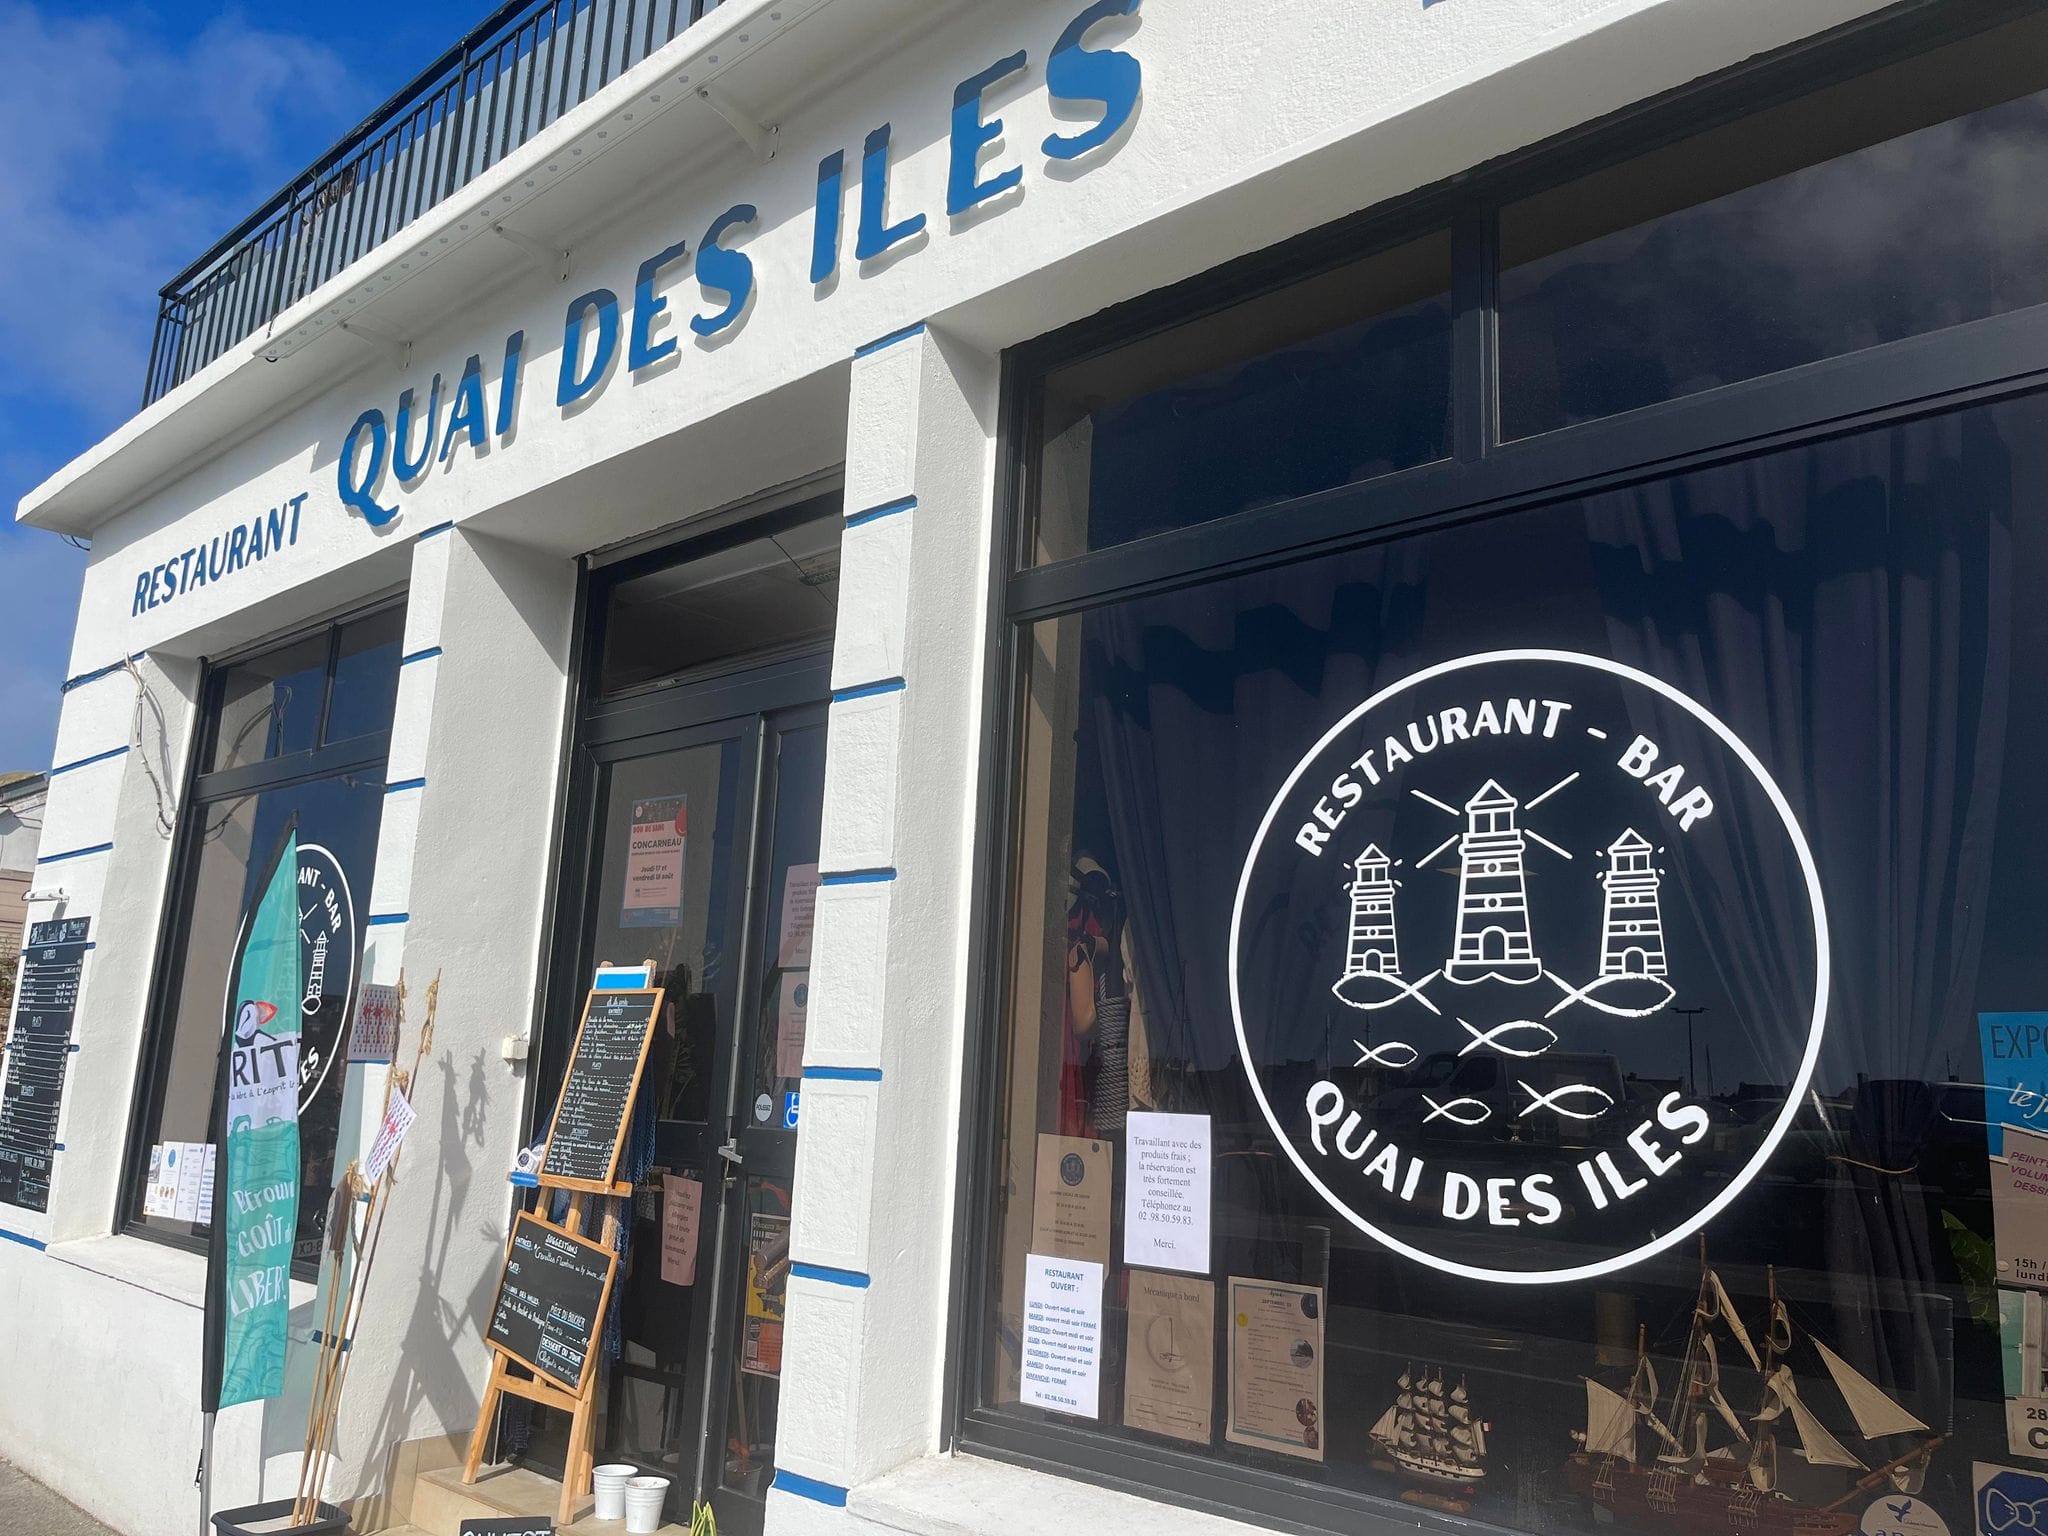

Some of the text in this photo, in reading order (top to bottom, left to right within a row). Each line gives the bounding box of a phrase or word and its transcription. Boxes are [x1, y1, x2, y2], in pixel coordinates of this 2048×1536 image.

[337, 0, 1142, 527] QUAI DES ILES
[132, 491, 309, 617] RESTAURANT
[1295, 698, 1572, 857] RESTAURANT
[1617, 734, 1714, 832] BAR
[632, 838, 682, 850] CONCARNEAU
[641, 865, 655, 873] Jeudi
[632, 873, 655, 881] vendredi
[298, 867, 321, 888] ANT
[325, 889, 342, 934] BAR
[2023, 1094, 2048, 1118] j
[1133, 1136, 1202, 1150] Travaillant avec des
[1141, 1150, 1169, 1161] produits
[1171, 1151, 1187, 1161] frais
[1306, 1080, 1710, 1226] QUAI DES ILES
[2010, 1152, 2048, 1168] PEINT
[1138, 1161, 1196, 1175] la réservation est
[1143, 1175, 1191, 1187] très fortement
[2013, 1180, 2048, 1196] DESSI
[1148, 1188, 1185, 1199] conseillée.
[1141, 1199, 1192, 1212] Téléphonez au
[1138, 1211, 1147, 1221] 02
[238, 1213, 283, 1257] GOÛT
[545, 1233, 578, 1255] SUGGESTIONS
[1153, 1237, 1176, 1249] Merci.
[2014, 1258, 2037, 1269] 15h
[1045, 1268, 1085, 1281] RESTAURANT
[228, 1265, 287, 1317] LIBER
[1050, 1281, 1075, 1292] OUVERT
[1183, 1292, 1201, 1304] bord
[1044, 1303, 1060, 1312] Ouvert
[1080, 1321, 1097, 1330] FERMÉ
[1052, 1328, 1068, 1338] Ouvert
[541, 1337, 582, 1364] DESSERT DU JOUR
[1041, 1338, 1057, 1348] Ouvert
[1057, 1341, 1068, 1349] midi
[1068, 1343, 1077, 1351] soir
[1077, 1345, 1094, 1354] FERMÉ
[1050, 1352, 1066, 1361] Ouvert
[1067, 1355, 1077, 1363] midi
[1083, 1358, 1093, 1366] soir
[1045, 1363, 1060, 1373] Ouvert
[1061, 1366, 1072, 1375] midi
[1077, 1369, 1087, 1377] soir
[1051, 1377, 1067, 1386] FERMÉ
[2026, 1407, 2048, 1421] 28
